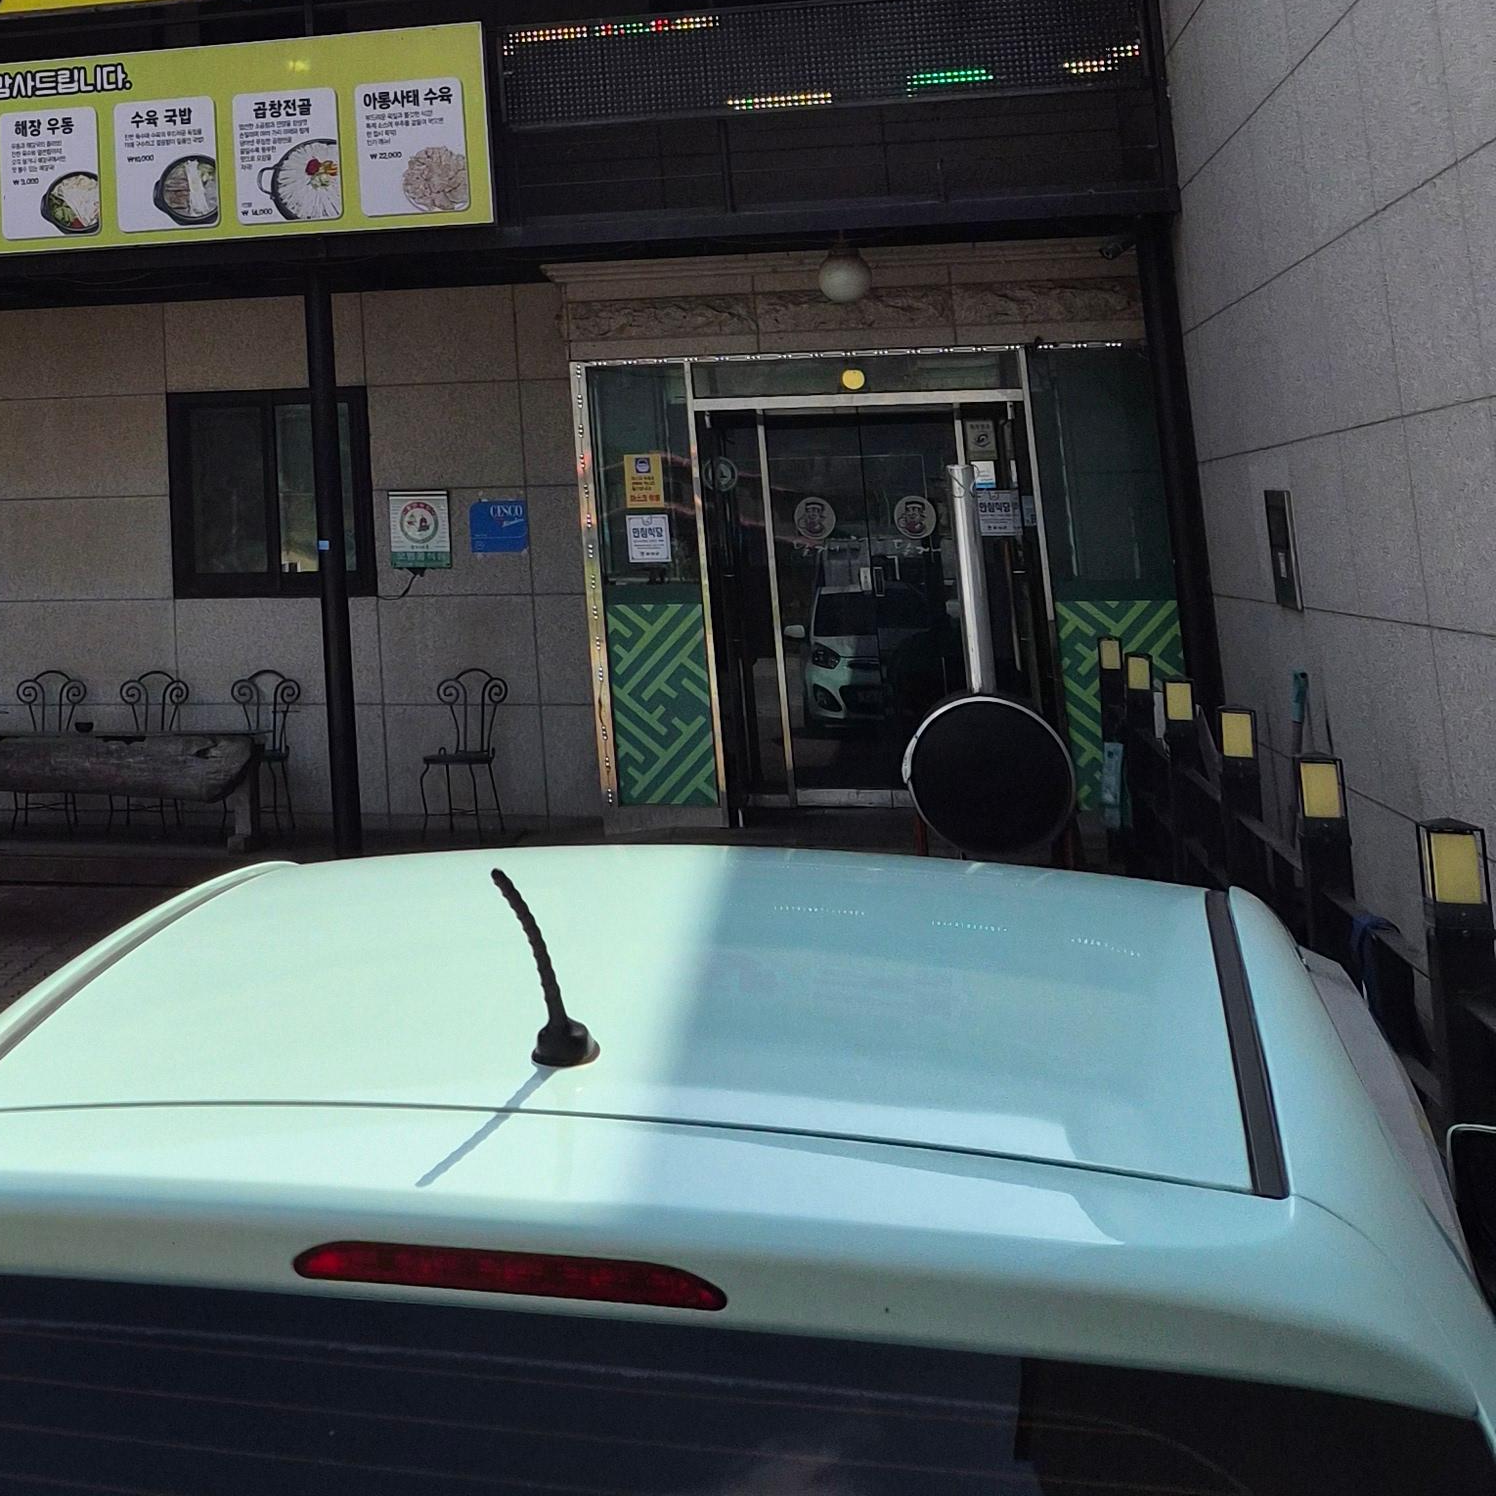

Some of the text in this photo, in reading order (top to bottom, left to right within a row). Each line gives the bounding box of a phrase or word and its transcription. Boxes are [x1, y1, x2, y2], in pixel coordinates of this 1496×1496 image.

[253, 98, 312, 119] 곱창전골
[363, 86, 453, 110] 아롱사태 수육
[14, 117, 74, 137] 해장 우동
[131, 107, 192, 128] 수육 국밥
